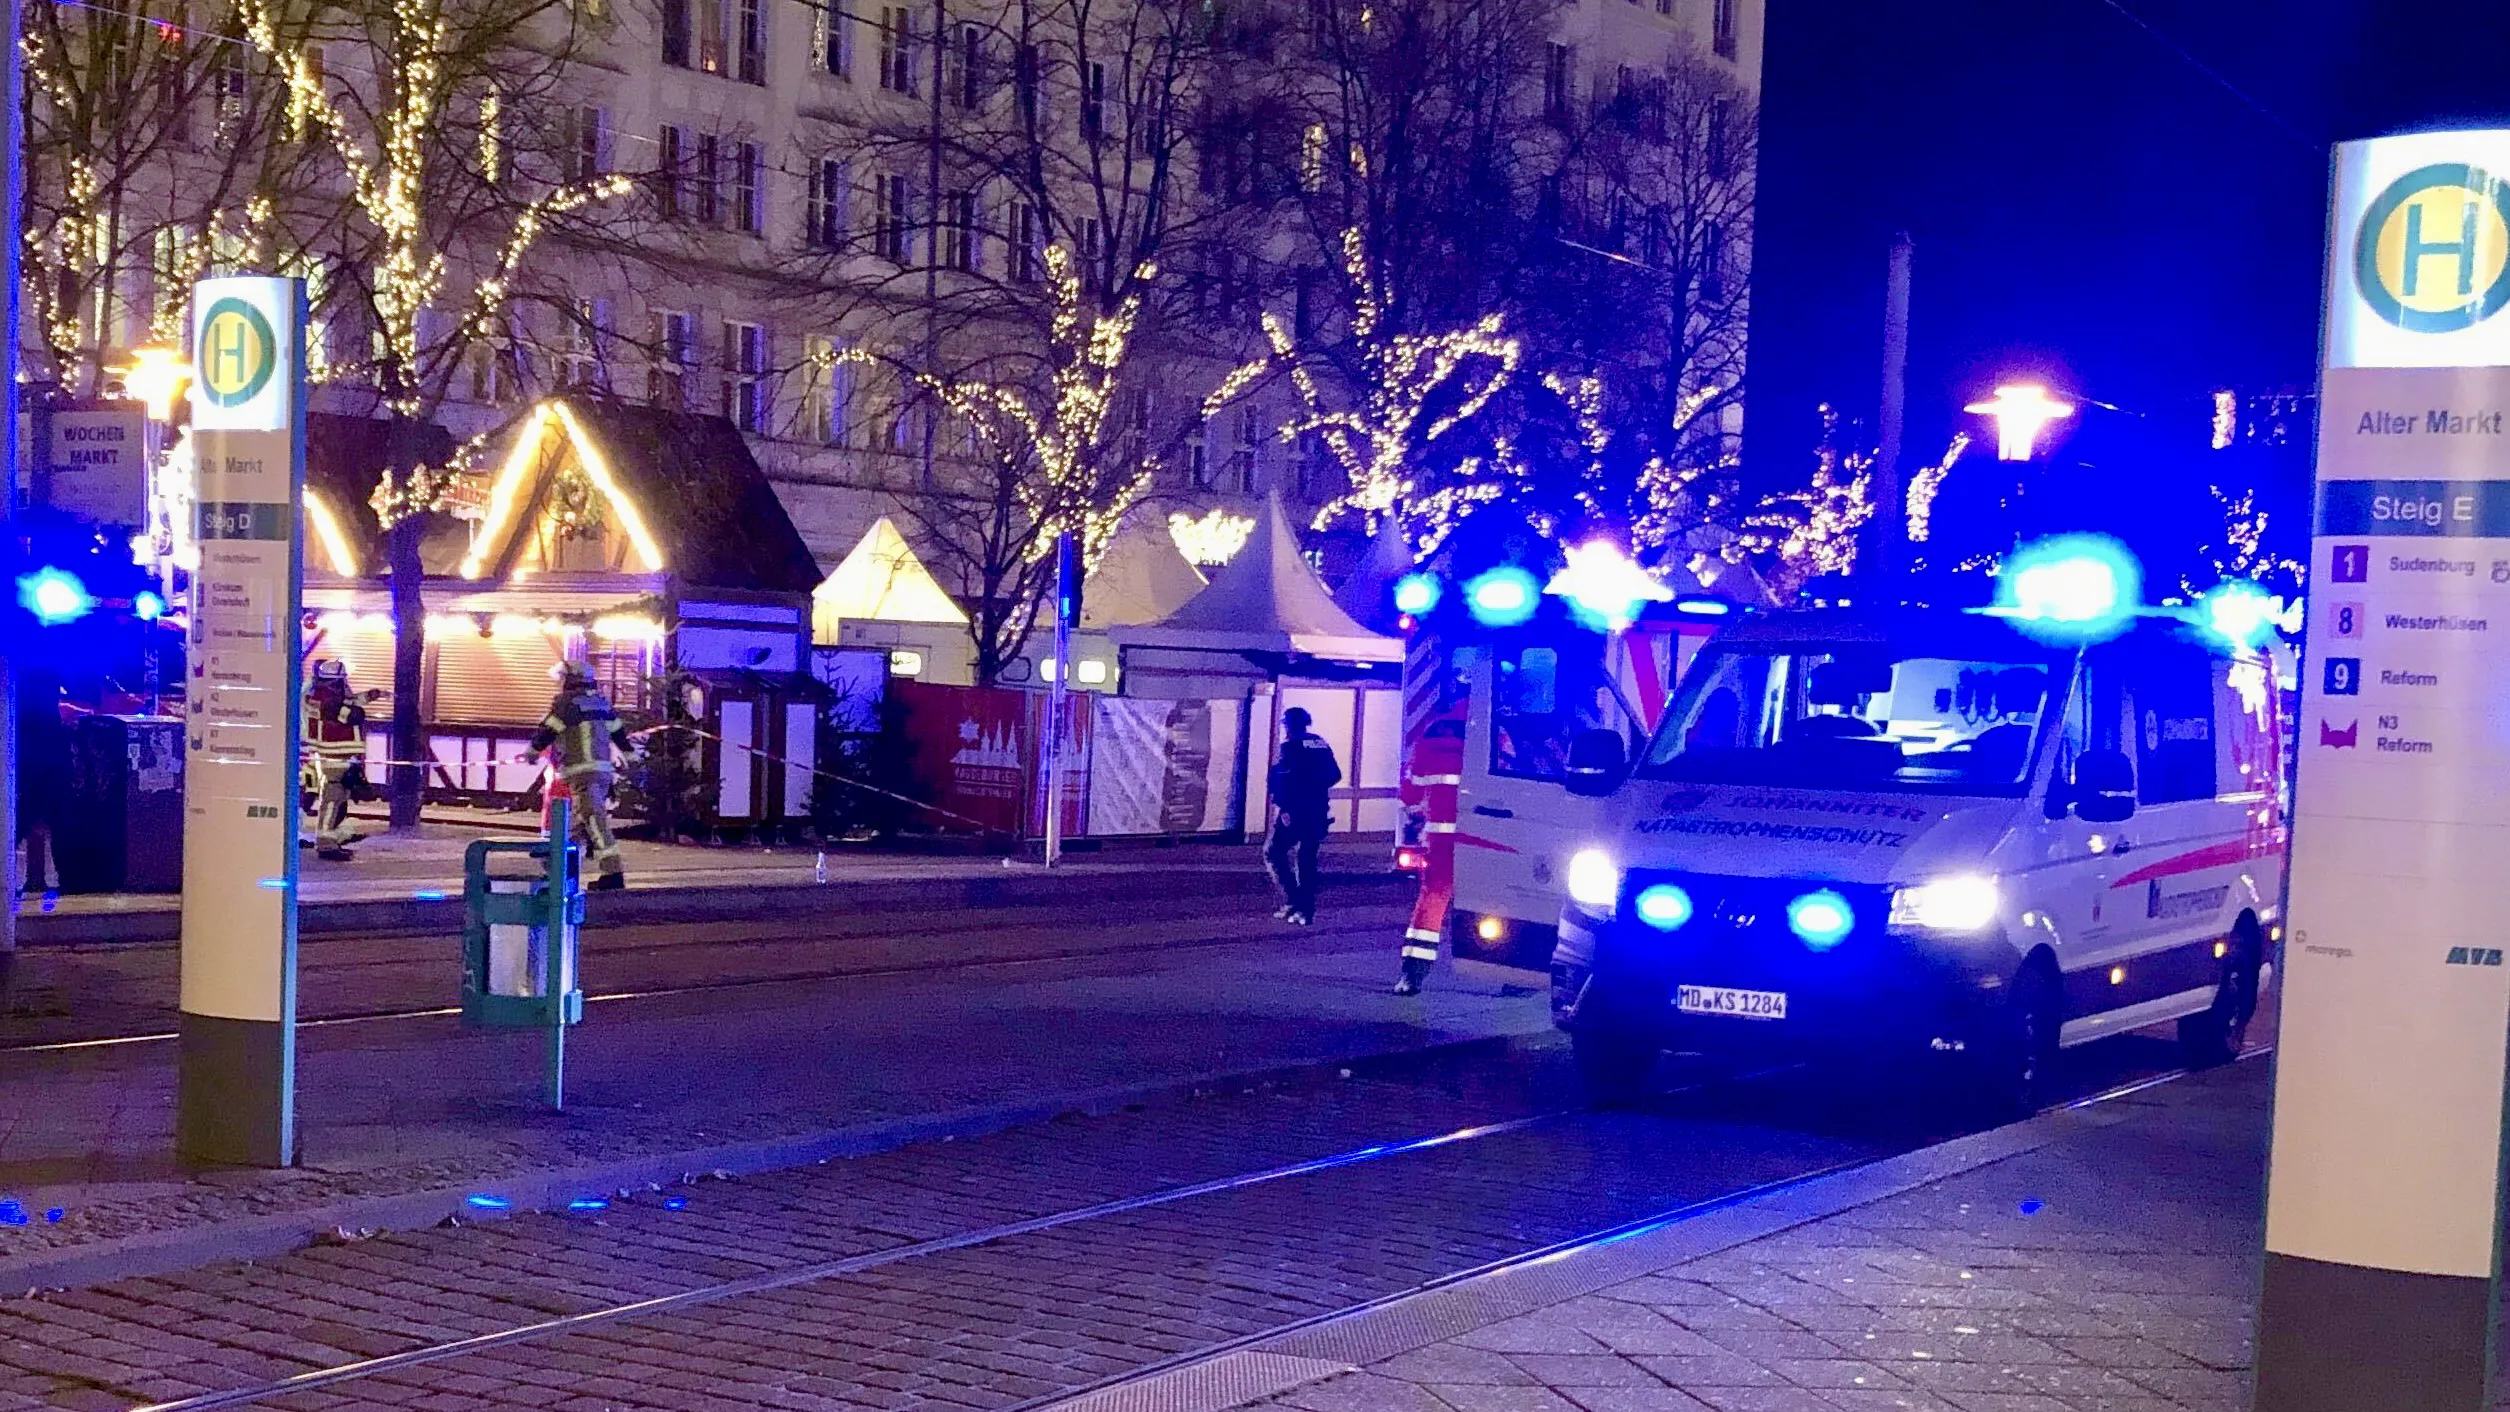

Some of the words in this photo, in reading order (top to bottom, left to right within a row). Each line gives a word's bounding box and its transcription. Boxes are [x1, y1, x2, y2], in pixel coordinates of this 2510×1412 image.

[2402, 203, 2478, 298] H
[213, 322, 245, 384] H
[64, 427, 124, 442] WOCHEN
[2357, 410, 2419, 435] Alter
[2425, 409, 2502, 435] Markt
[70, 449, 119, 465] MARKT
[225, 456, 263, 474] Markt
[239, 512, 251, 530] D
[2372, 496, 2443, 527] Steig
[2452, 496, 2475, 521] E
[2343, 551, 2356, 578] 1
[2389, 556, 2476, 577] Sudenburg
[2338, 606, 2354, 635] 8
[2385, 612, 2488, 632] Westerhüsen
[2333, 662, 2350, 690] 9
[2379, 669, 2438, 687] Reform
[2377, 714, 2399, 731] N3
[2376, 736, 2433, 754] Reform
[1632, 818, 1906, 848] KATASTROPHENSCHUTZ
[1679, 987, 1701, 1008] MD
[1714, 991, 1736, 1011] KS
[1740, 993, 1783, 1015] 1284
